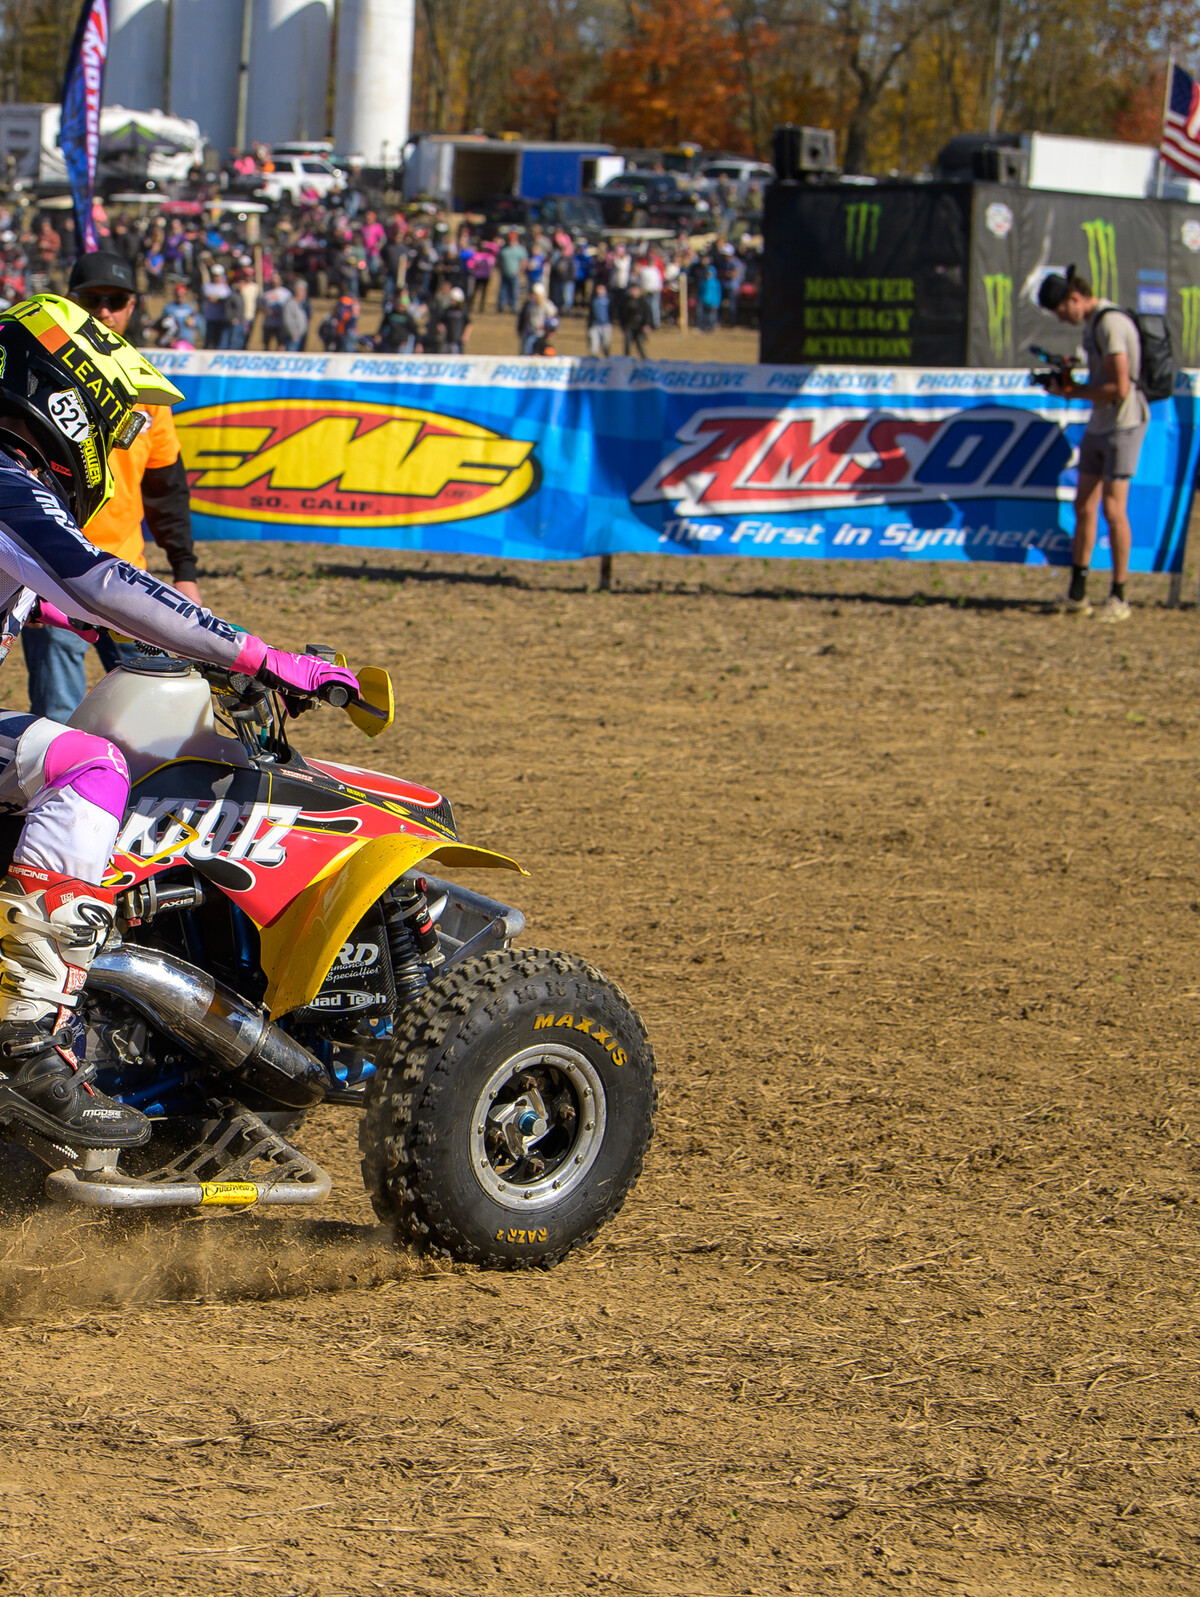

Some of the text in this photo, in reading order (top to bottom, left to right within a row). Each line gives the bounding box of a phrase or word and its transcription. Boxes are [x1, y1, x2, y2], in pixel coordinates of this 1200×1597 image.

[805, 278, 914, 301] MONSTER
[804, 308, 914, 332] ENERGY
[802, 338, 913, 358] ACTIVATION
[208, 353, 330, 375] PROGRESSIVE
[349, 358, 477, 380] PROGRESSIVE
[491, 363, 611, 385] PROGRESSIVE
[61, 347, 123, 420] LEATT
[628, 366, 750, 388] PROGRESSIVE
[766, 370, 895, 391] PROGRESSIVE
[50, 395, 89, 440] 521
[81, 437, 103, 488] POWER
[249, 495, 382, 515] SO. CALIF.
[659, 517, 1074, 553] The First in Synthetic
[114, 560, 237, 643] RACING
[116, 796, 303, 863] KLOTZ
[13, 866, 49, 881] RACING
[337, 942, 379, 967] RD
[310, 992, 387, 1008] uad Tech
[533, 1013, 628, 1067] MAXXIS
[82, 1109, 122, 1117] MOOSE
